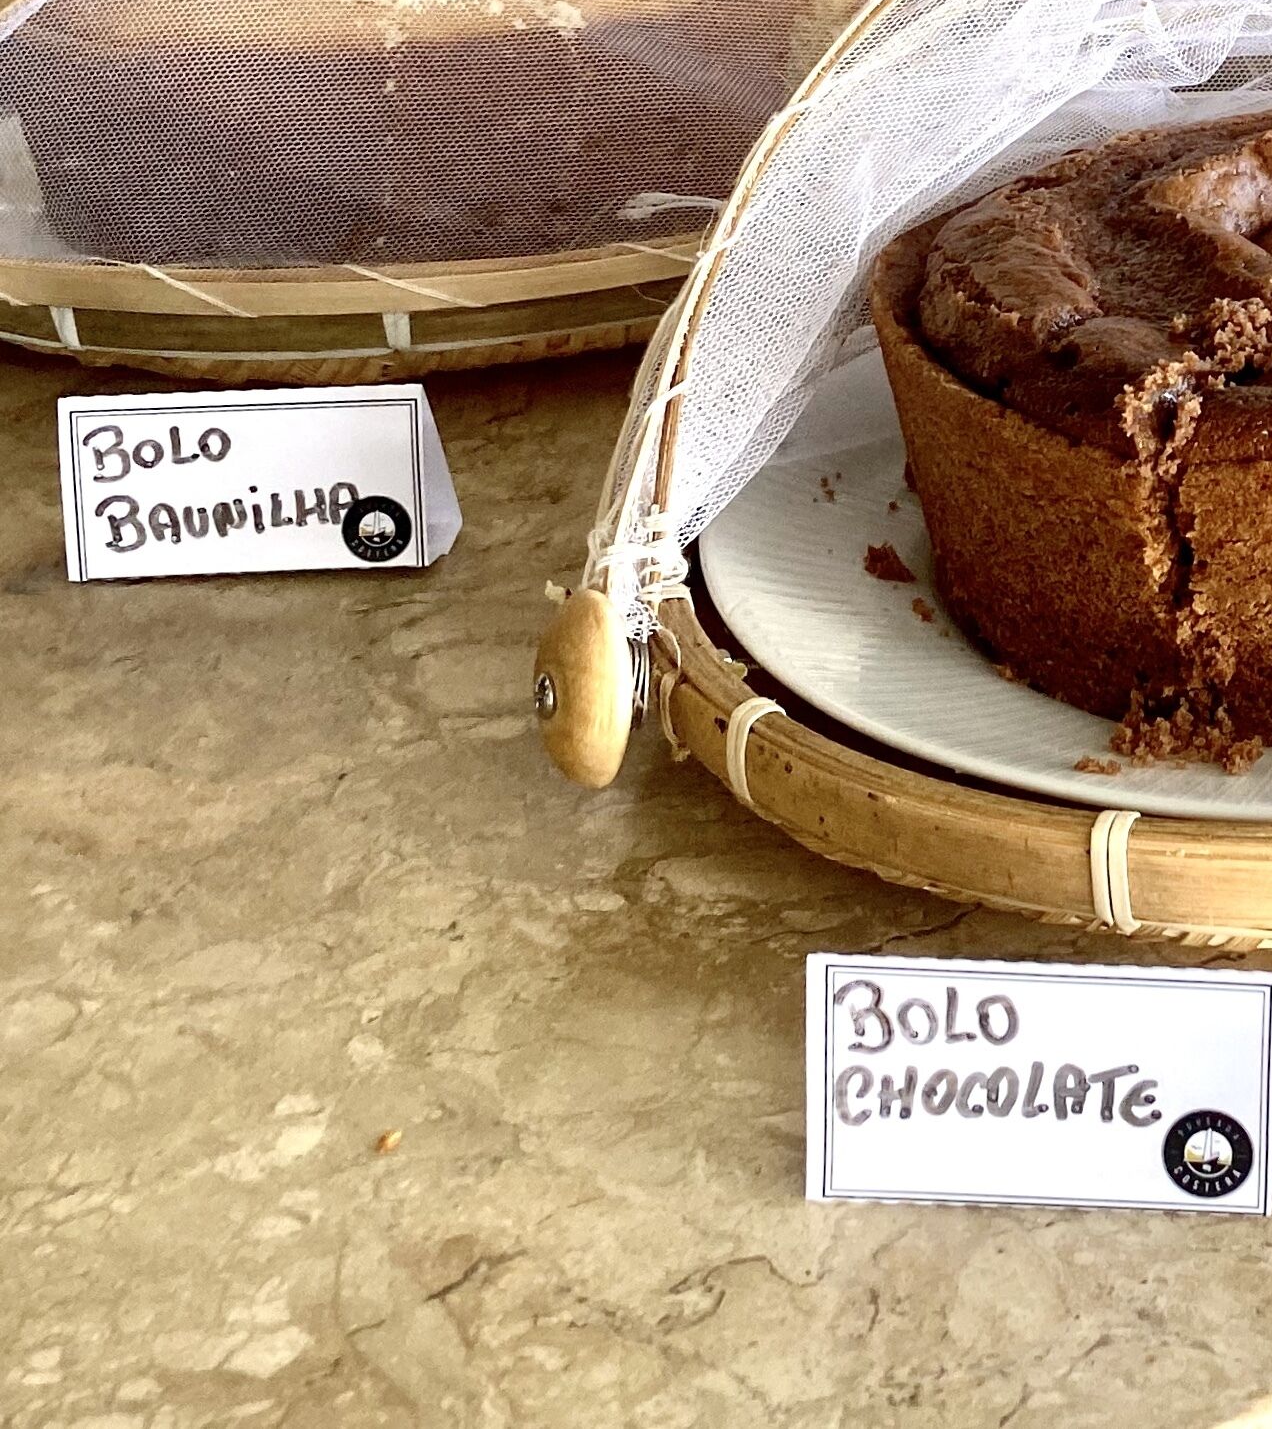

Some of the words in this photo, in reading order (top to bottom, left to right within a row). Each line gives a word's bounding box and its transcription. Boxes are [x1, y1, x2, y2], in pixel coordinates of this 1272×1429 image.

[83, 424, 231, 483] BOLO
[834, 979, 1019, 1054] BOLO
[835, 1060, 1162, 1127] CHOCOLATE
